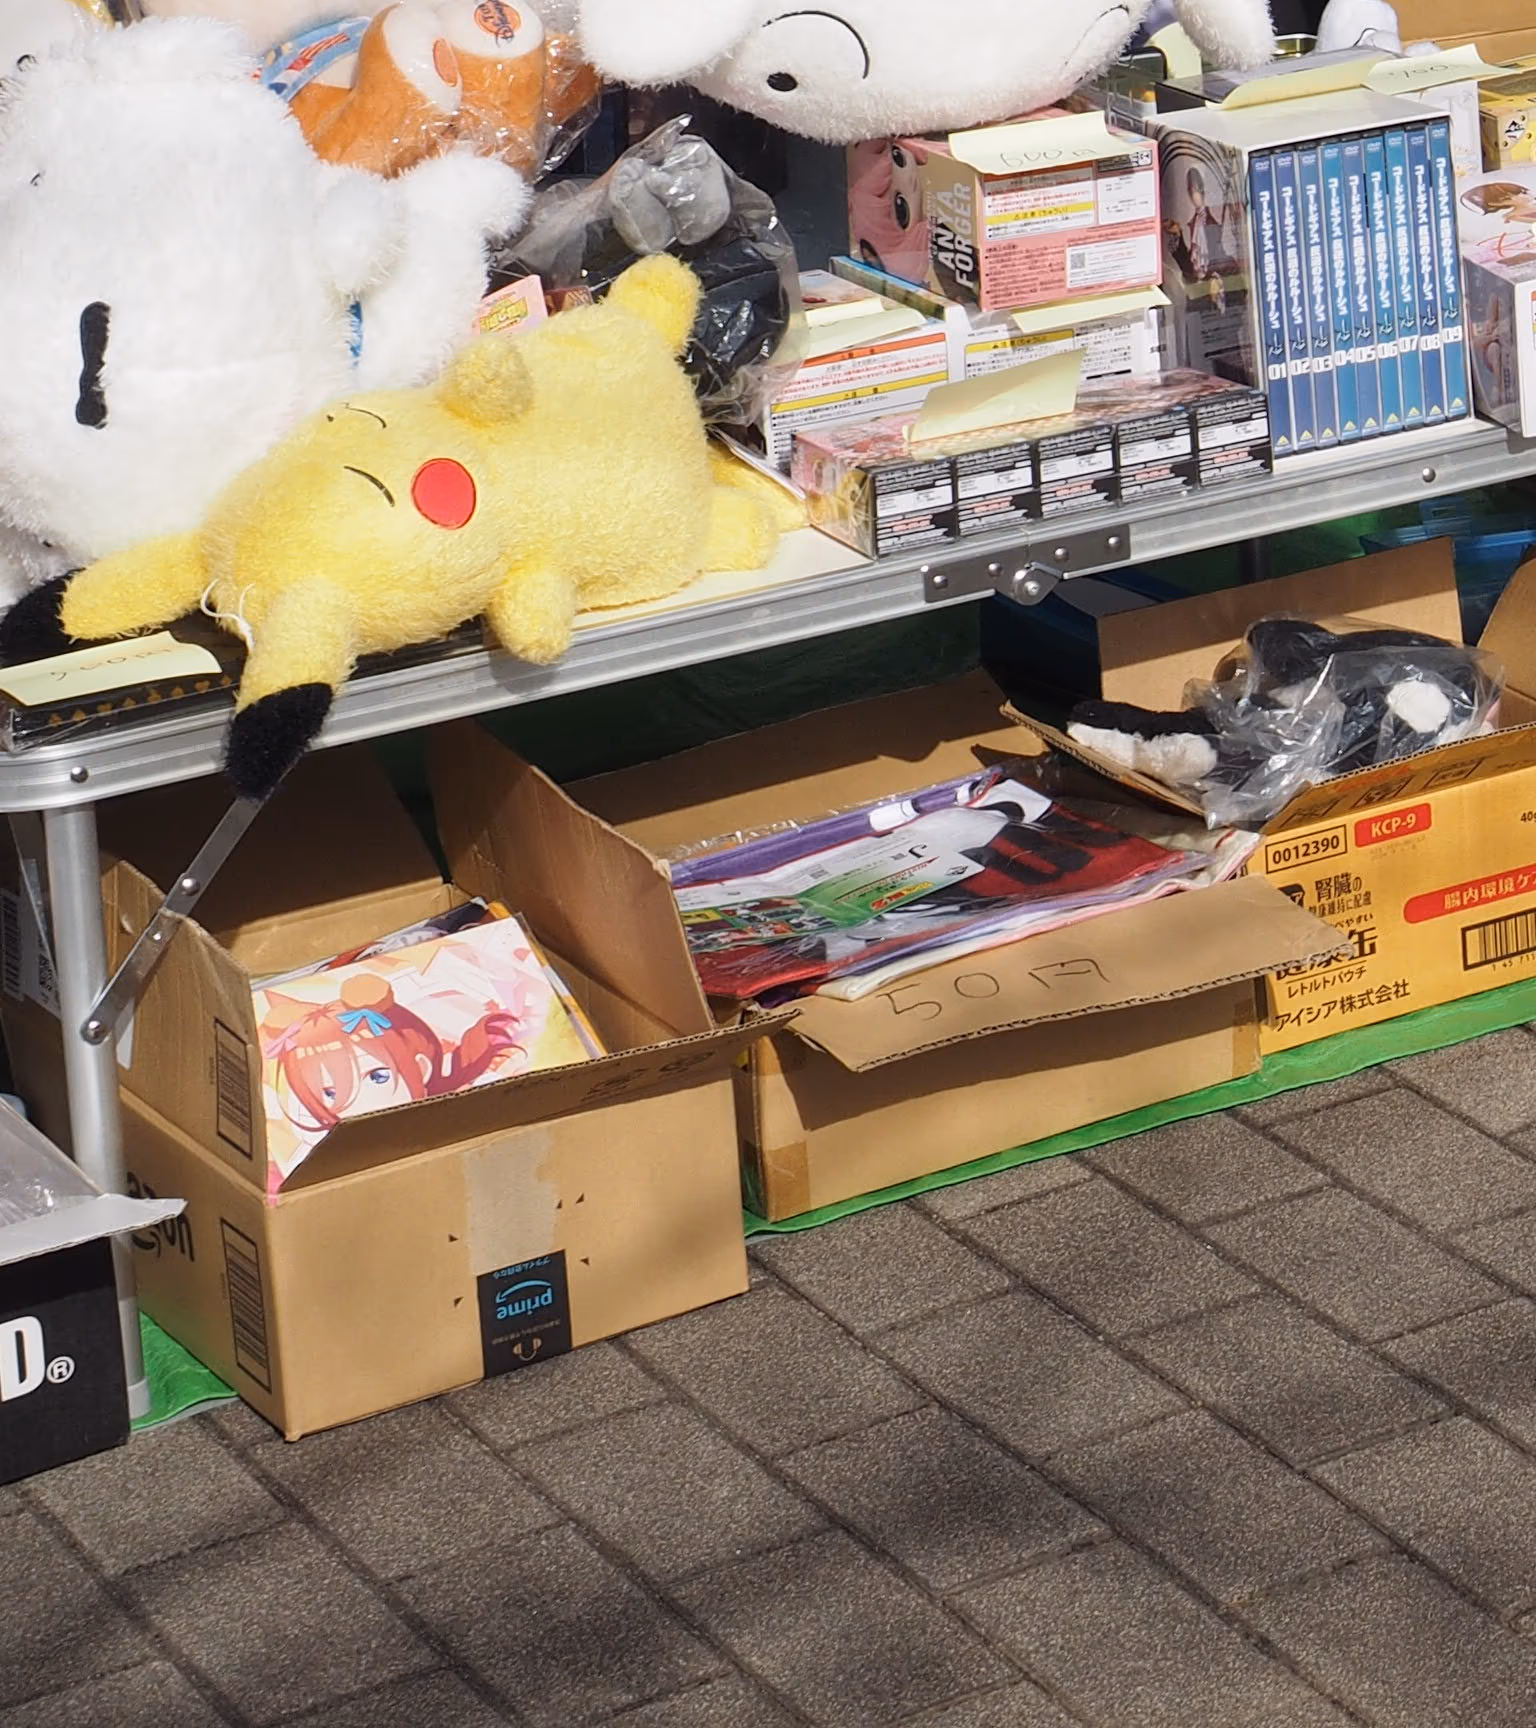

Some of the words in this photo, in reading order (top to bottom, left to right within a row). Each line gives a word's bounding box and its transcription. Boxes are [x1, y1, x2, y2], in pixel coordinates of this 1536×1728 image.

[935, 191, 956, 270] ANYA
[952, 181, 976, 289] FORGER
[1421, 333, 1441, 352] 08
[1442, 324, 1463, 343] 09
[1356, 344, 1377, 363] 05
[1377, 341, 1399, 359] 06
[1400, 335, 1419, 354] 07
[1291, 357, 1312, 377] 02
[1312, 354, 1335, 374] 03
[1335, 347, 1355, 367] 04
[1268, 363, 1287, 381] 01
[1371, 812, 1416, 839] KCP-9
[1272, 834, 1341, 865] 0012390
[1314, 872, 1363, 904] 腎臓の
[1287, 964, 1368, 1000] レトルトパウチ
[1275, 977, 1411, 1033] アイシア株式会社
[497, 1285, 554, 1320] prime
